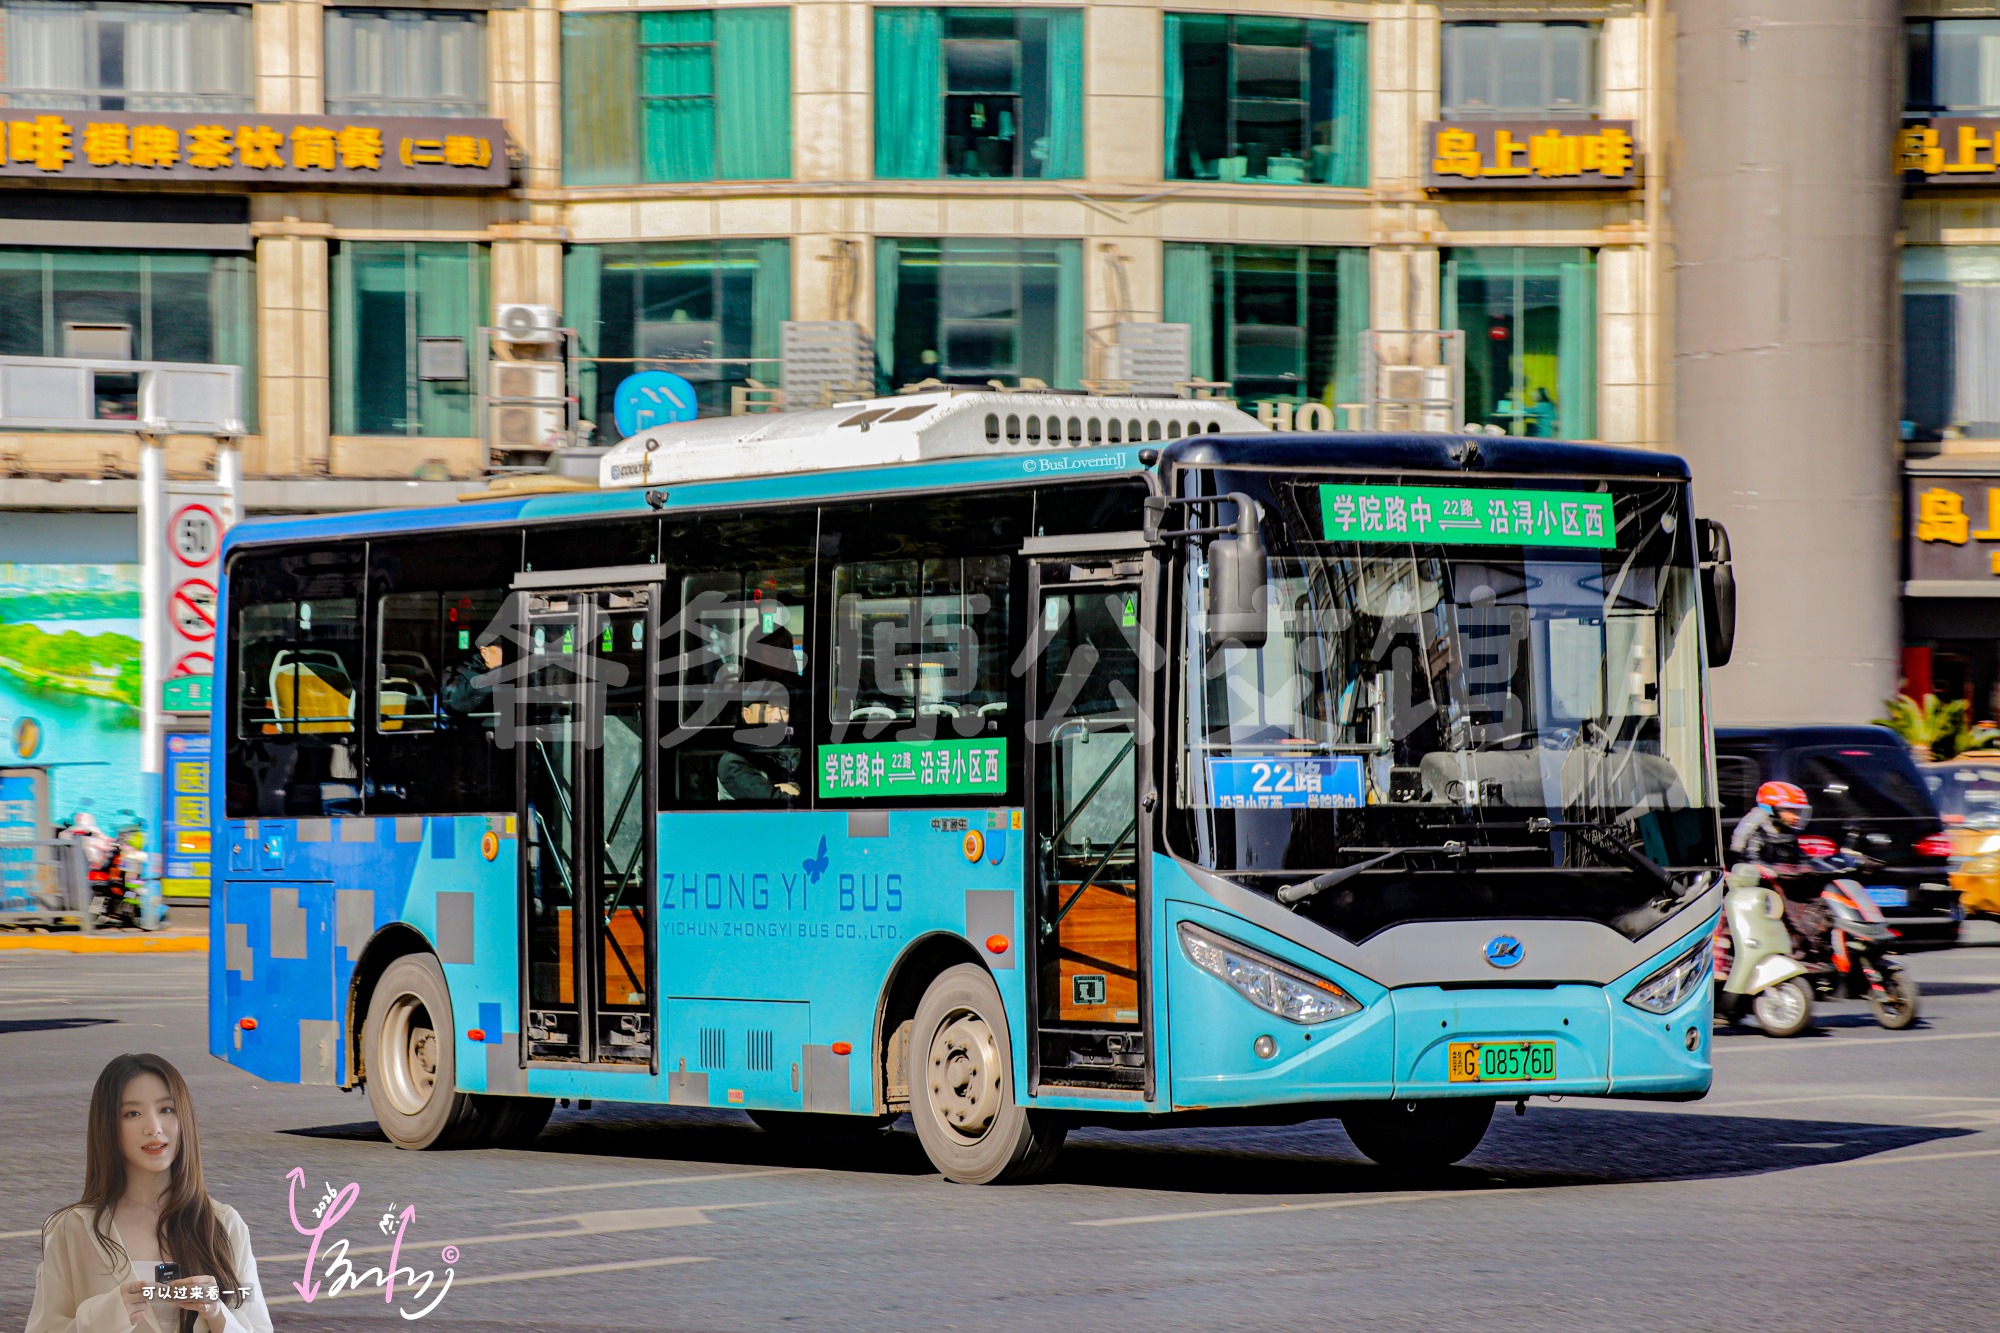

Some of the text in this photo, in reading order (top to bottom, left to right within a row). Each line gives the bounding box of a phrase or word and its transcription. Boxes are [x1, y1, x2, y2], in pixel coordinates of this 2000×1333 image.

[1892, 125, 2000, 176] 岛上
[1333, 494, 1604, 538] 学院路中 沿浔小区西
[1442, 499, 1474, 518] 22路
[825, 748, 999, 790] 学院路中 沿浔小区西
[892, 752, 912, 769] 22路
[1251, 761, 1322, 793] 22路
[662, 872, 902, 912] ZHONG YI BUS
[662, 921, 718, 937] YICHUN
[723, 922, 792, 938] ZHONGYI
[798, 923, 829, 938] BUS
